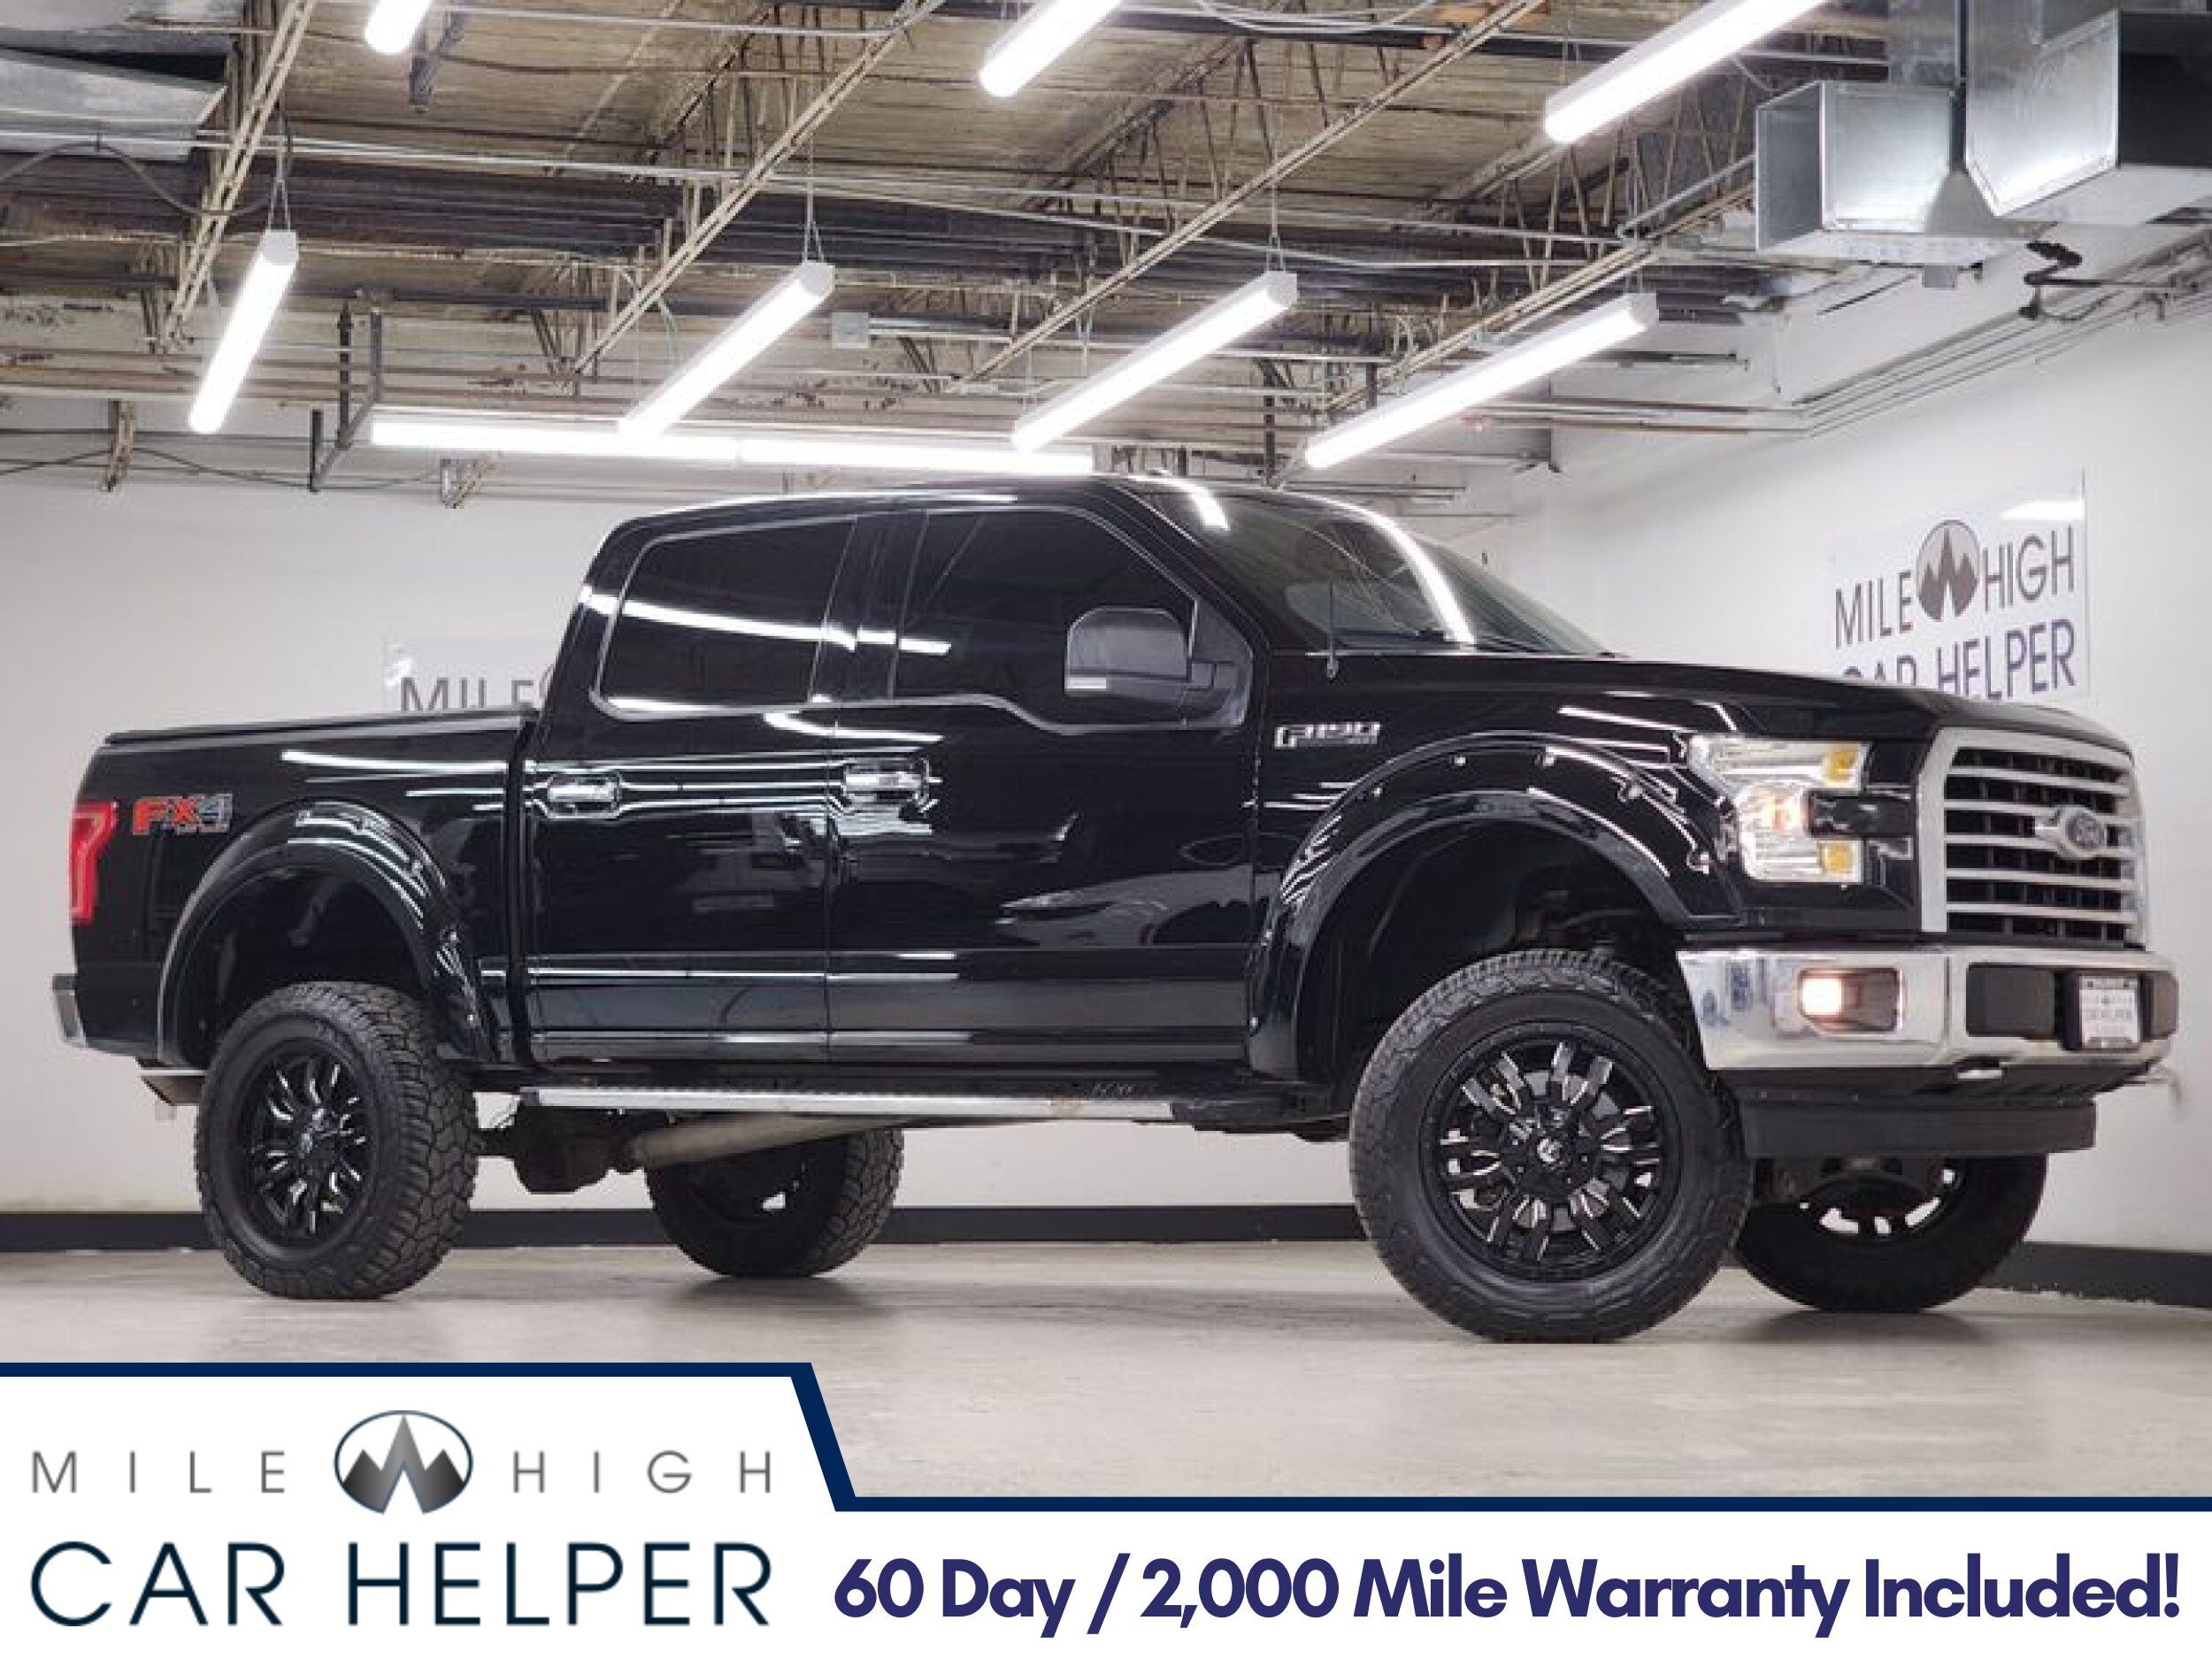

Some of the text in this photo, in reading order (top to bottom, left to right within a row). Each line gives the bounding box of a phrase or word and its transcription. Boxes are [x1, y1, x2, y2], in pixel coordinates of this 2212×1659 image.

[1835, 525, 2075, 649] MILE HIGH
[1938, 618, 2077, 700] HELPER
